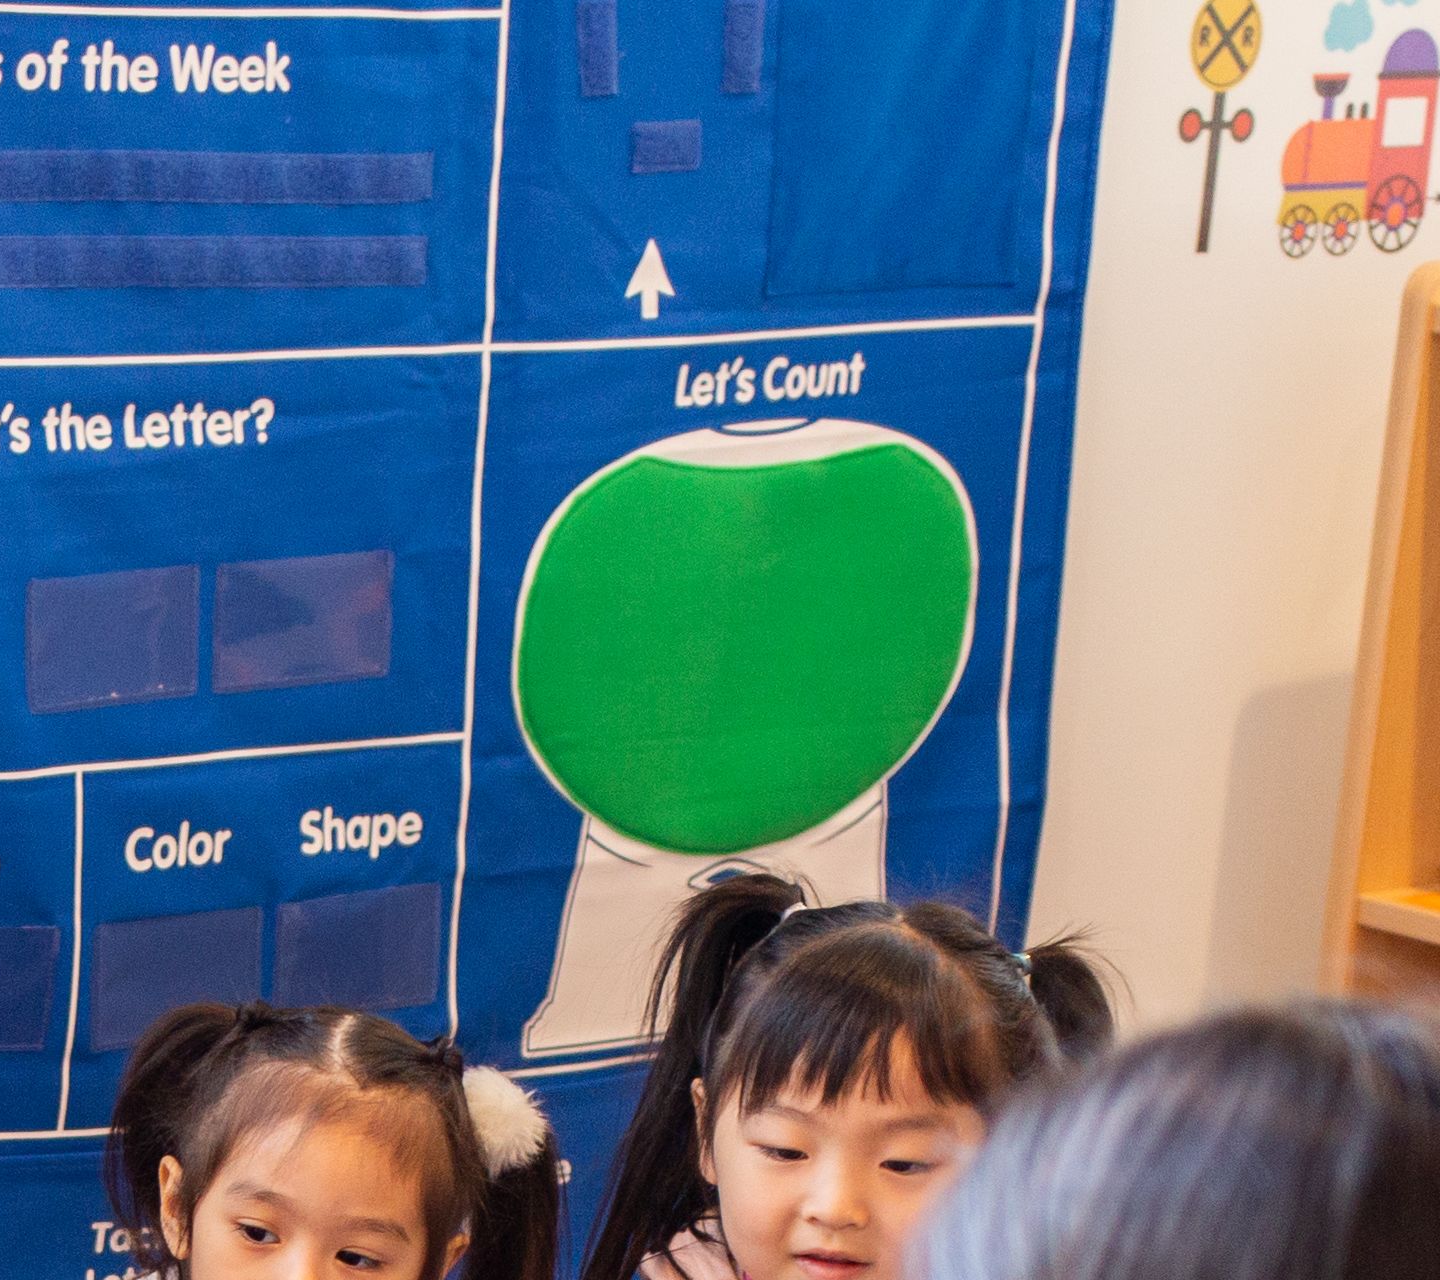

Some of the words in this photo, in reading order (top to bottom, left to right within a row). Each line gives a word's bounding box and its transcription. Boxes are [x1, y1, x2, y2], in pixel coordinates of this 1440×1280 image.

[15, 39, 69, 91] of
[81, 40, 158, 92] the
[169, 41, 291, 93] Week
[675, 356, 757, 408] Let's
[763, 352, 866, 401] Count
[41, 402, 113, 452] the
[123, 397, 275, 450] Letter?
[124, 820, 232, 872] Color
[299, 806, 423, 861] Shape
